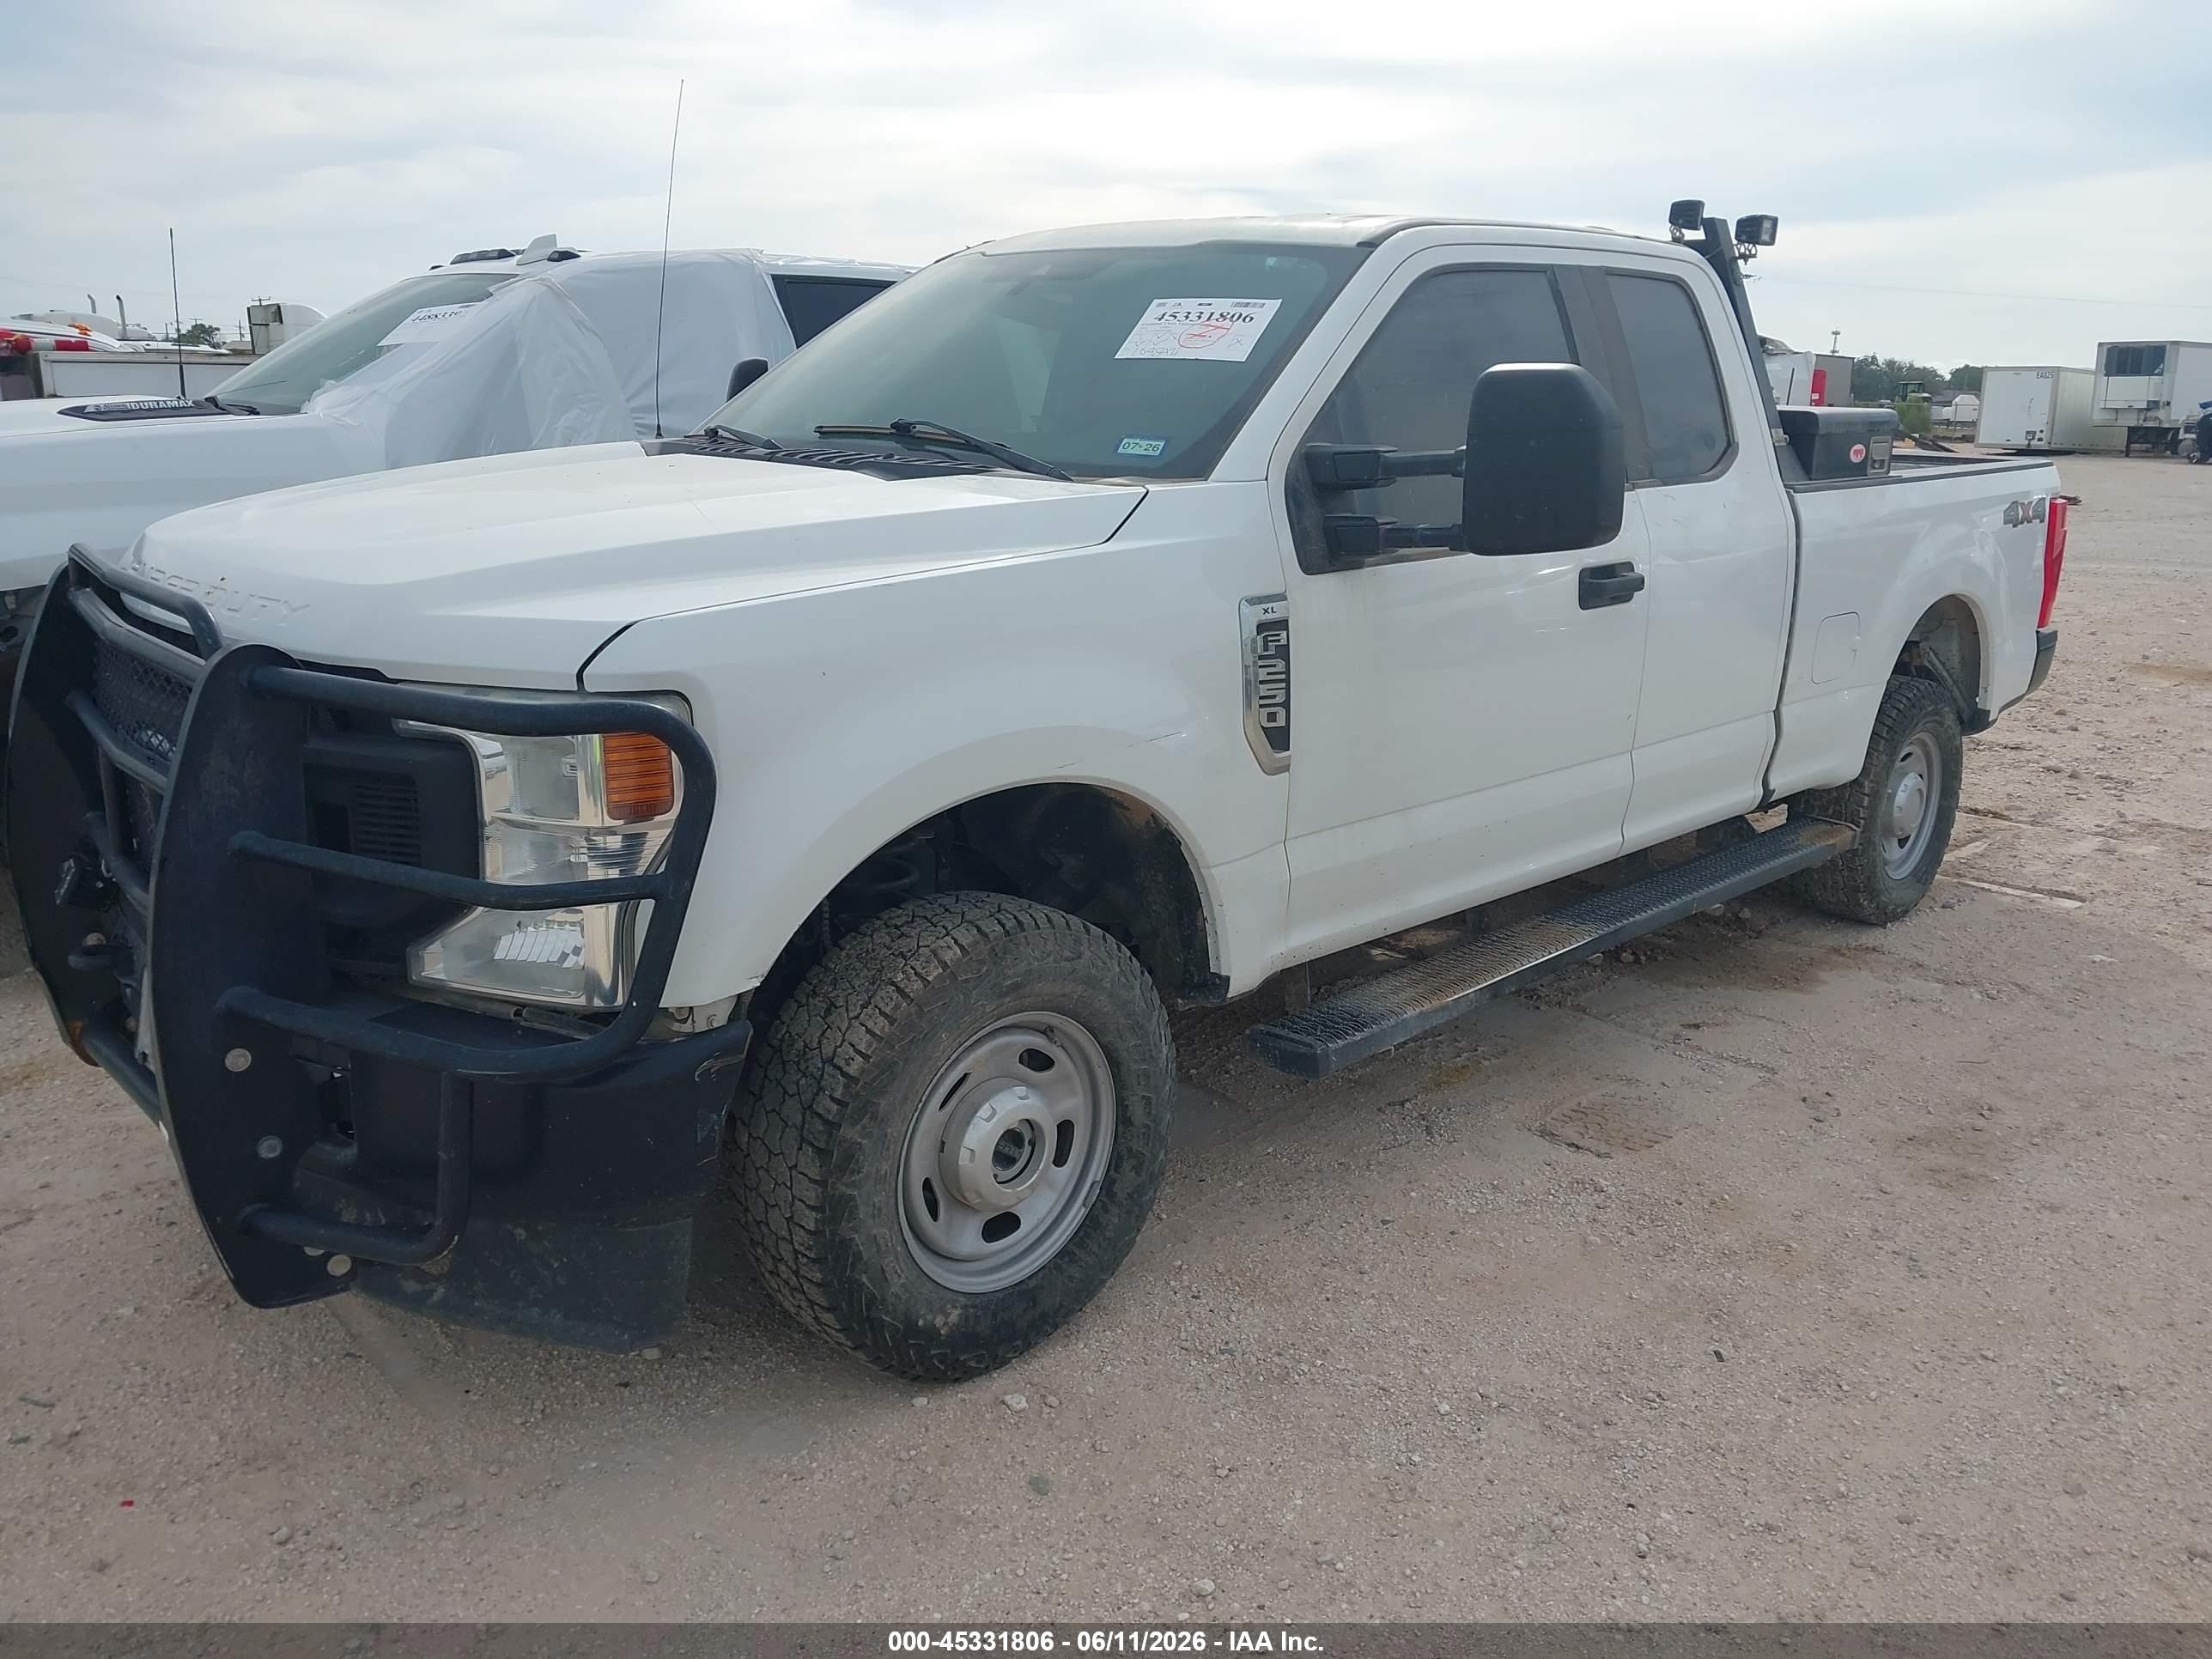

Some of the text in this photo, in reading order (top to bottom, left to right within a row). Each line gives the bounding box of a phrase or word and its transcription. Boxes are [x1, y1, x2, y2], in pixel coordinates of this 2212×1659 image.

[1153, 311, 1257, 323] 45331806
[130, 399, 195, 410] DURAMAX
[1262, 605, 1278, 616] XL
[1257, 630, 1288, 728] F250
